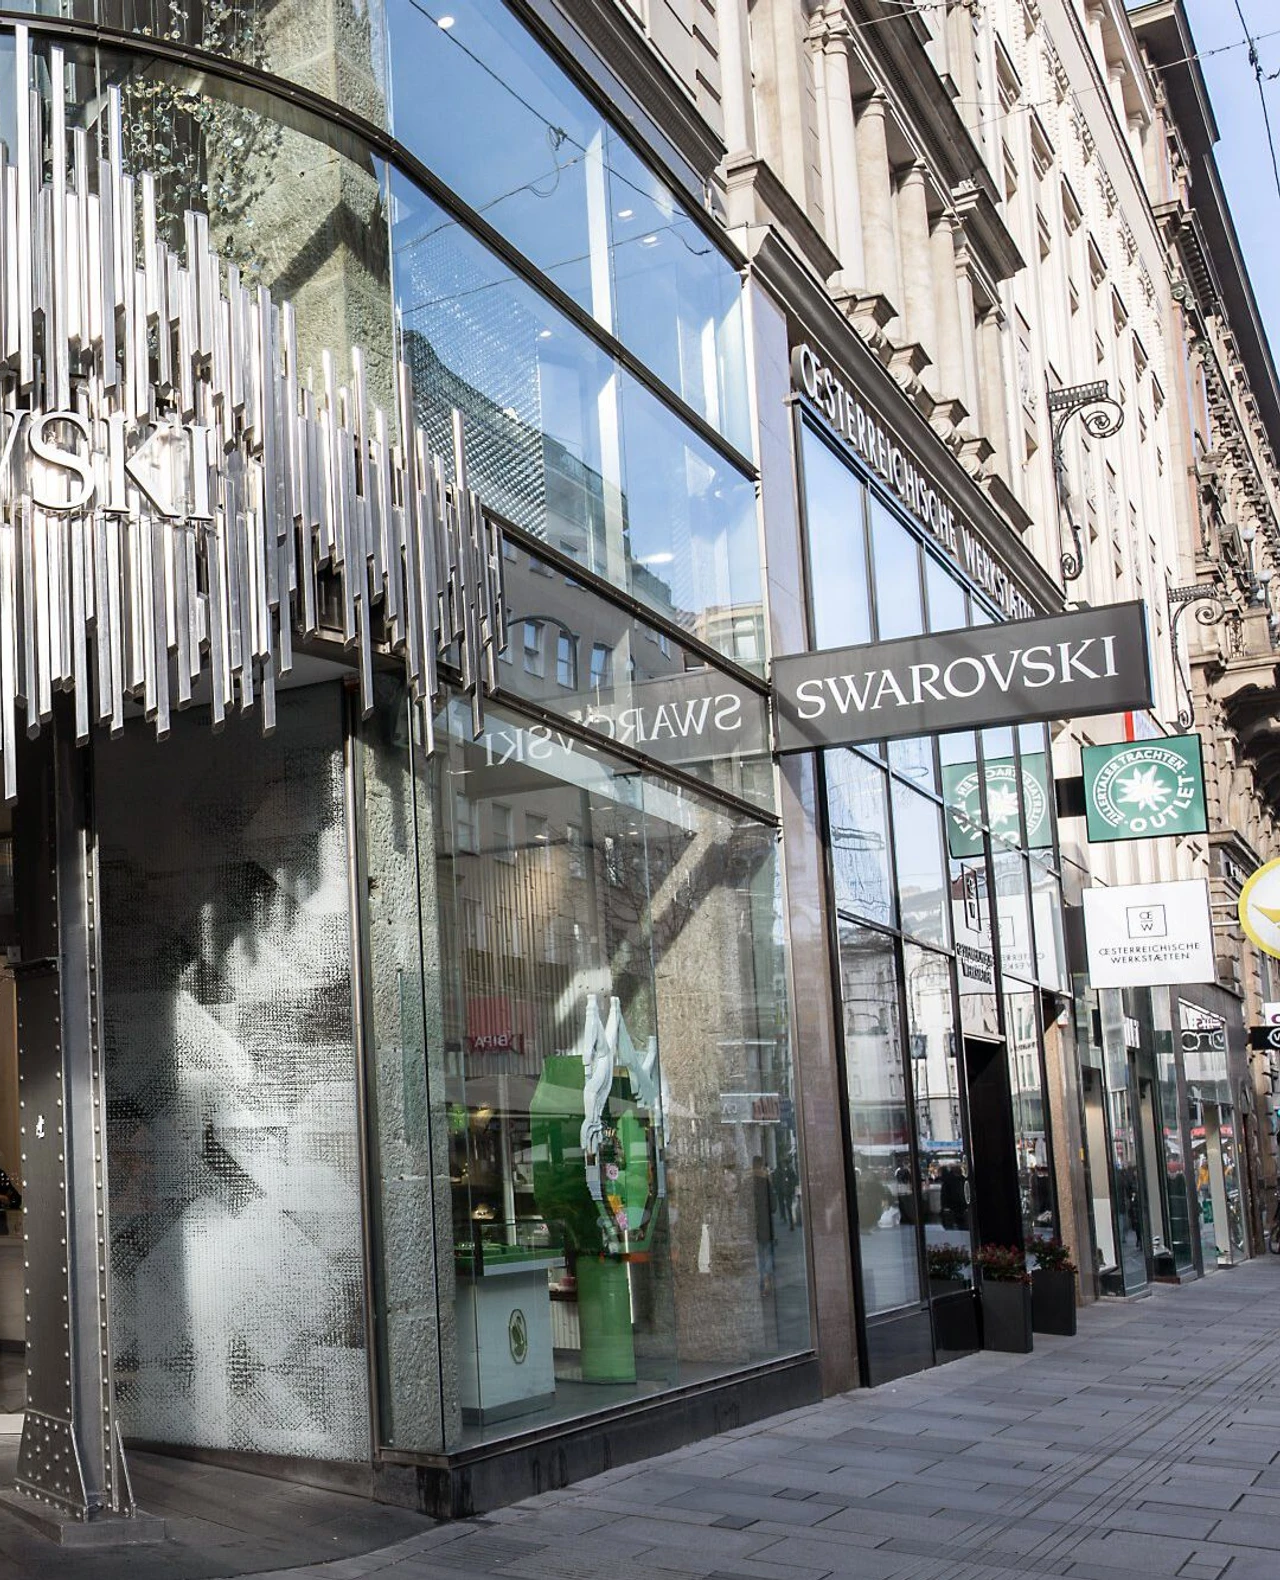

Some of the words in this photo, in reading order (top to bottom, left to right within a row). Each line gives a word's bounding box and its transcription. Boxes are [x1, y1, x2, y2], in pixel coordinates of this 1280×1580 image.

[796, 635, 1120, 720] SWAROVSKI
[1097, 761, 1124, 826] ZILLERTALER
[1118, 750, 1186, 772] TRACHTEN
[1129, 775, 1195, 832] OUTLET
